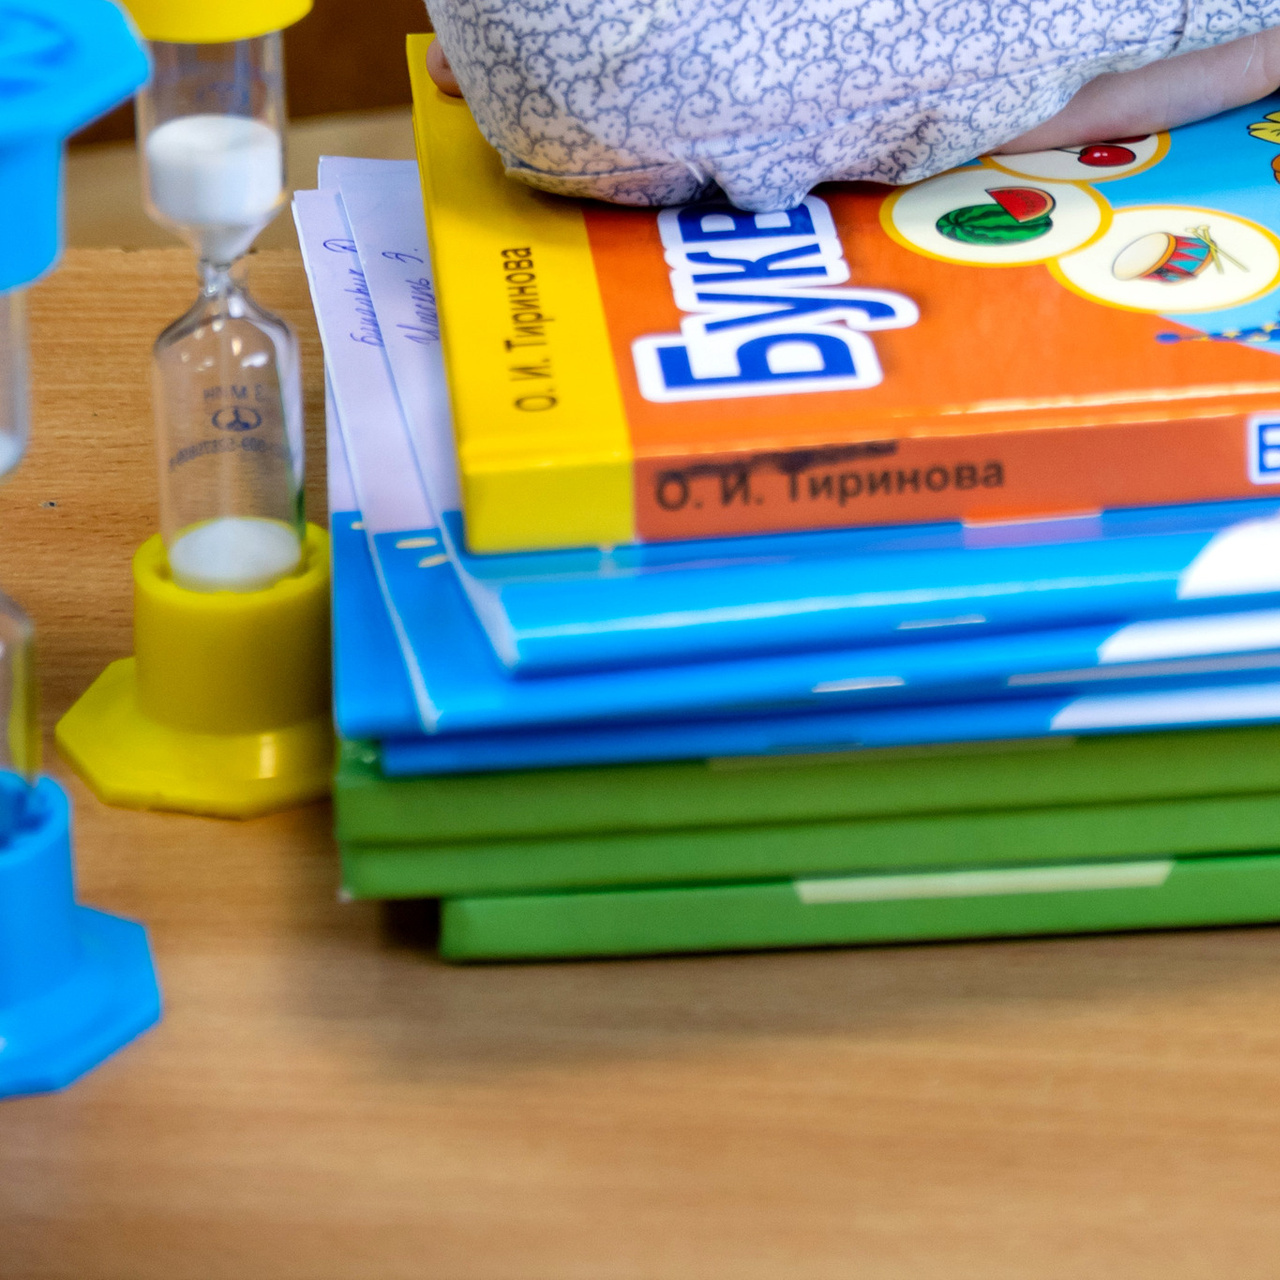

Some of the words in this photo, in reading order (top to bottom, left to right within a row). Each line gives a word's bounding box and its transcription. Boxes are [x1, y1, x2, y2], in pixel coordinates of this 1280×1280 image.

[500, 246, 556, 353] Тиринова
[513, 387, 559, 413] О.
[655, 470, 703, 512] О.
[785, 458, 1006, 508] Тиринова
